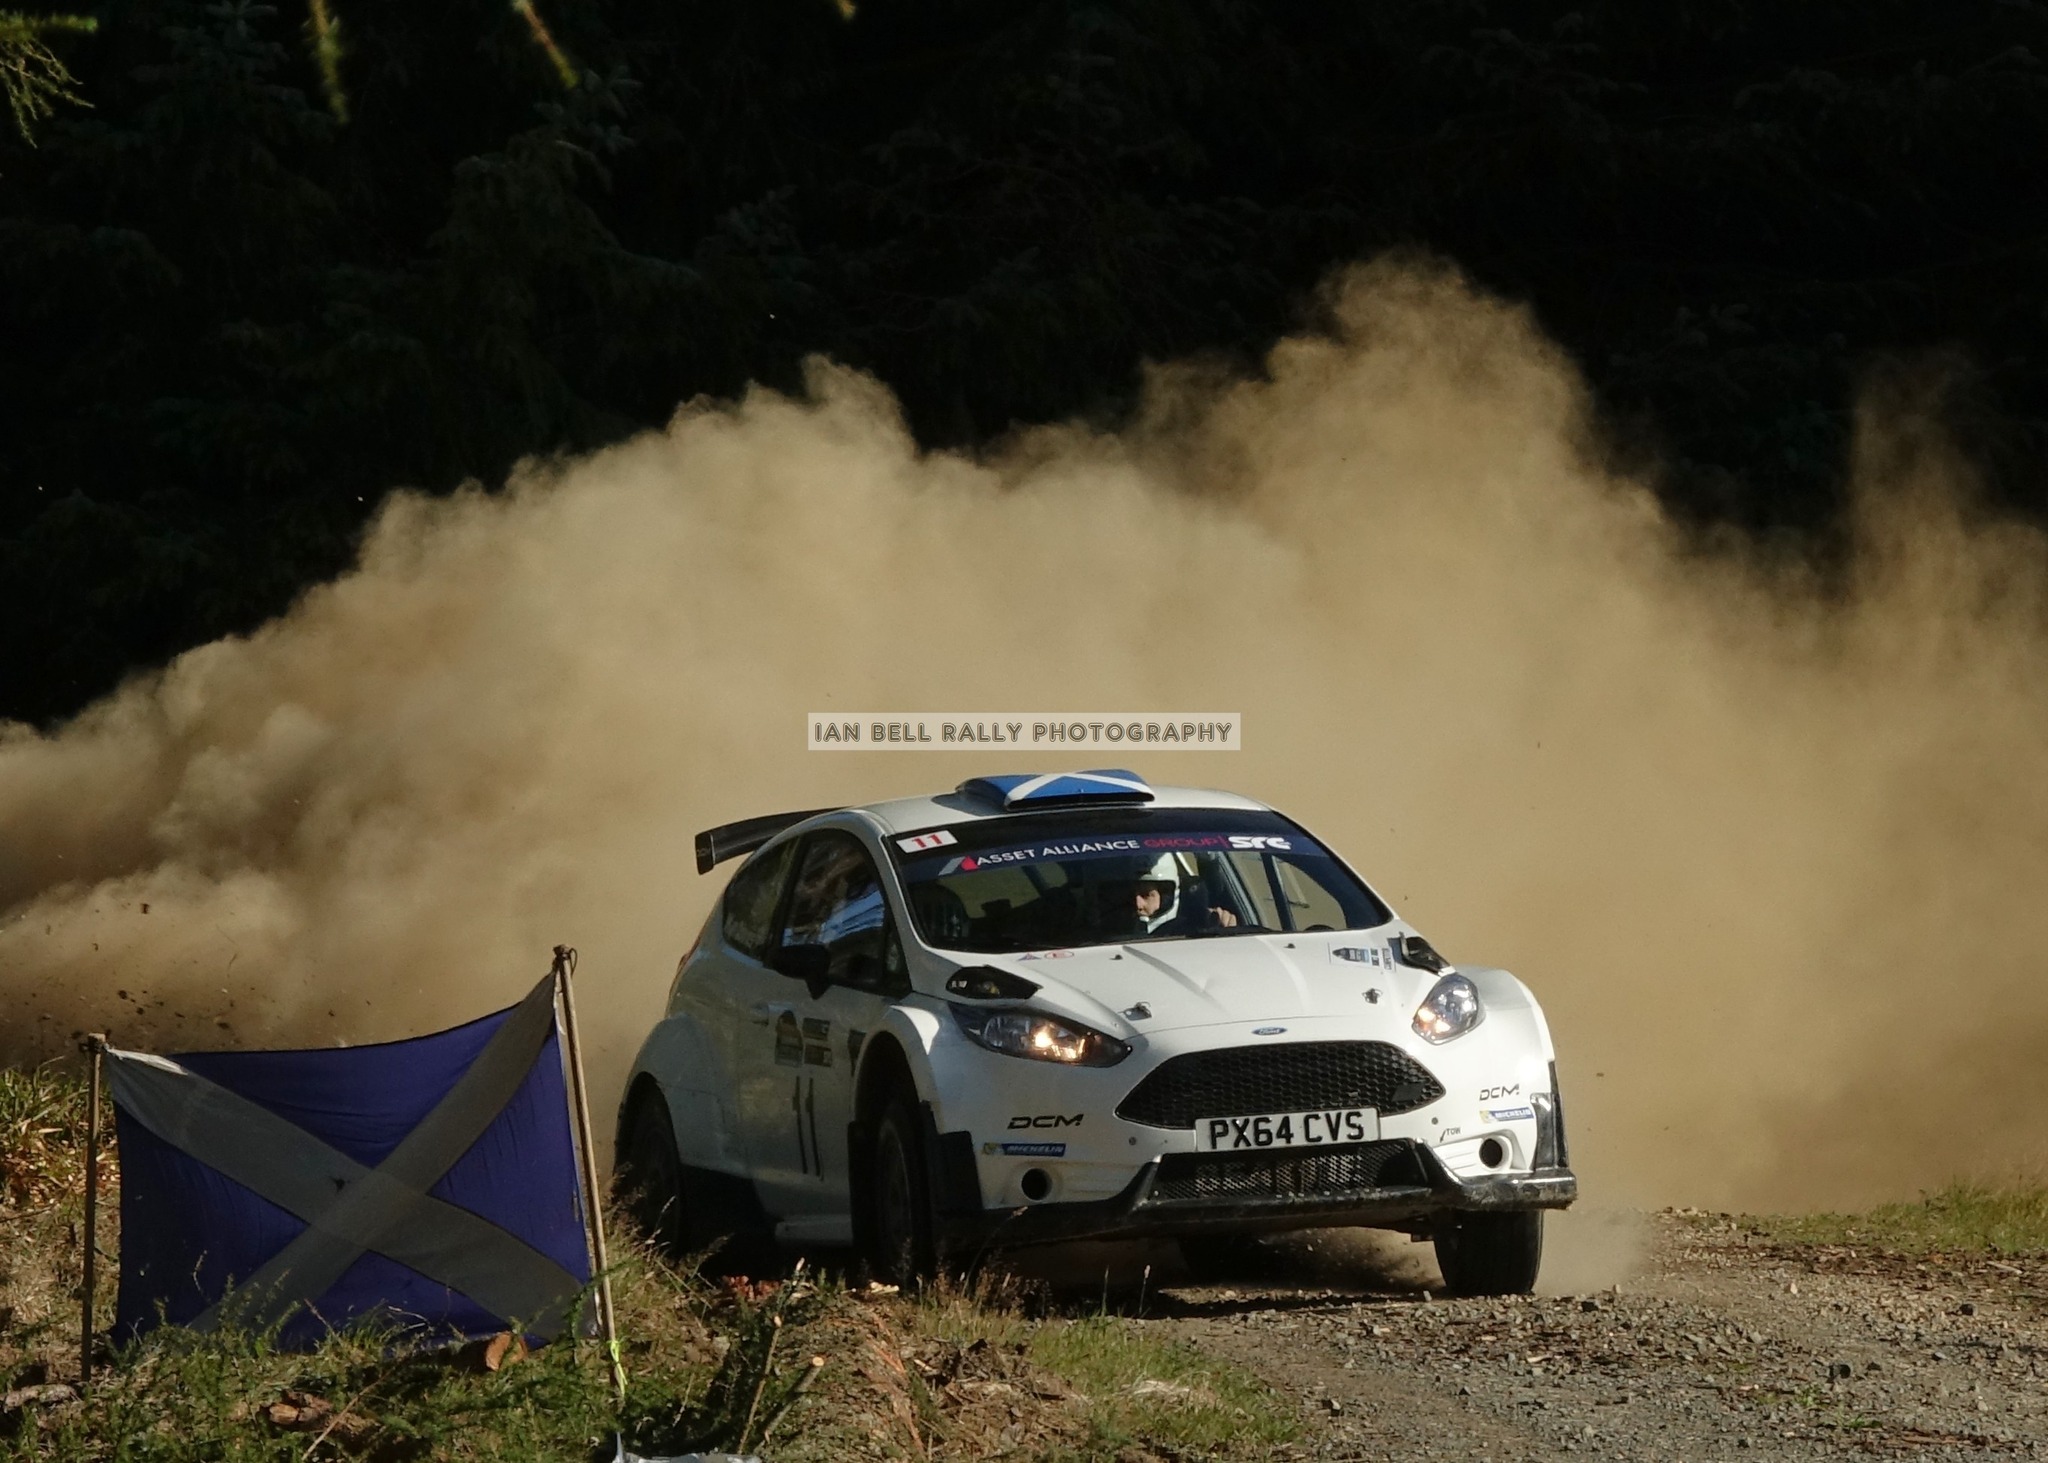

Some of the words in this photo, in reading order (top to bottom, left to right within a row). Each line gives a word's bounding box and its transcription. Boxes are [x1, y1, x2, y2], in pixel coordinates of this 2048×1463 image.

[912, 833, 943, 848] 11
[977, 849, 1035, 866] ASSET
[1042, 839, 1140, 857] ALLIANCE
[1143, 836, 1218, 848] GROUP
[1209, 1116, 1294, 1150] PX64
[1303, 1111, 1364, 1143] CVS
